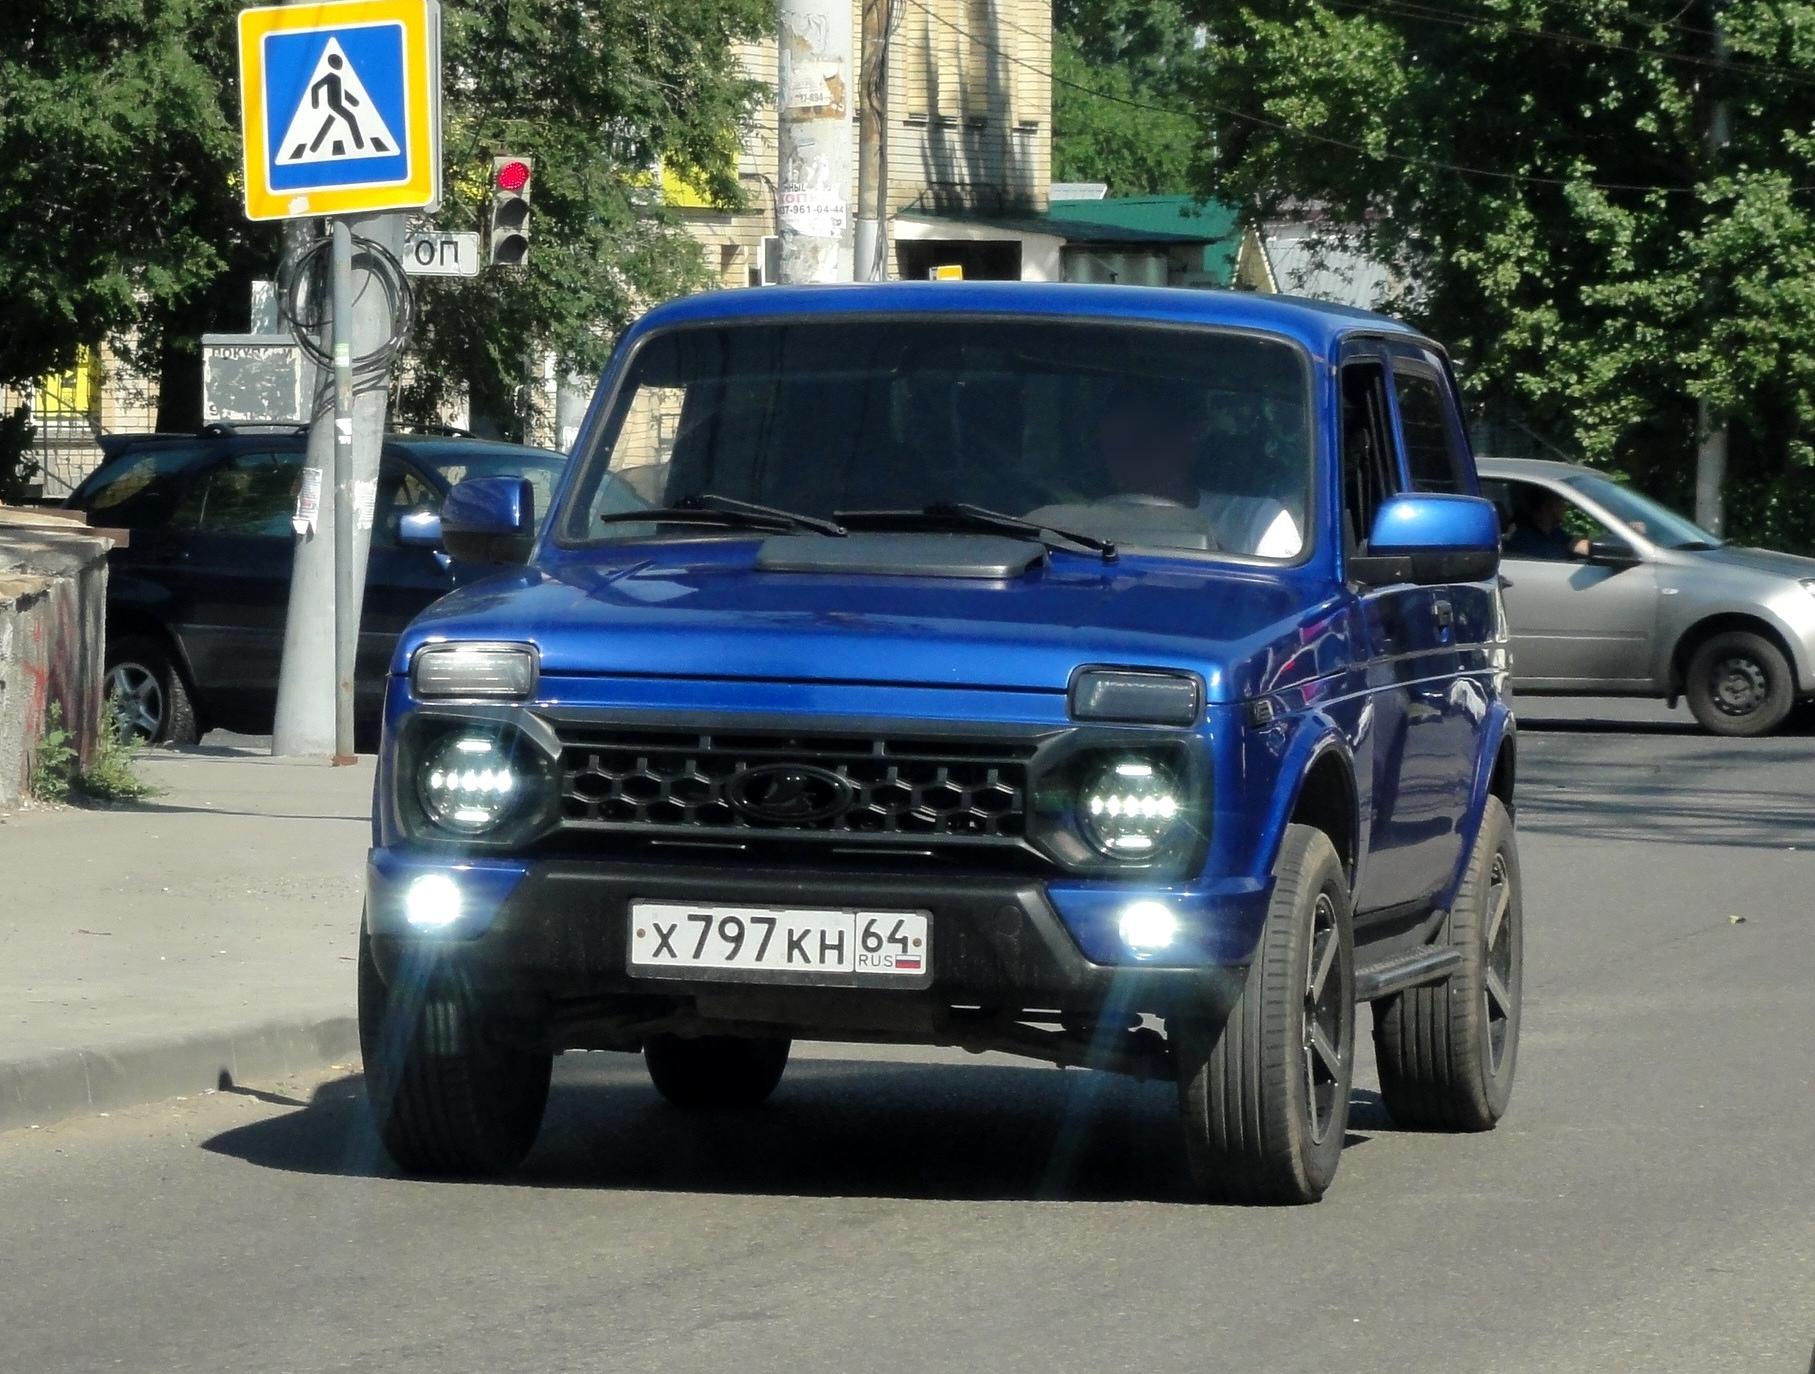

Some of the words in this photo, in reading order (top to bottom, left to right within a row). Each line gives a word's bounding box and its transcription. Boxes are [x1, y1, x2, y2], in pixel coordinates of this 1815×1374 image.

[405, 240, 459, 267] ОП
[861, 918, 909, 954] 64
[858, 954, 893, 967] RUS
